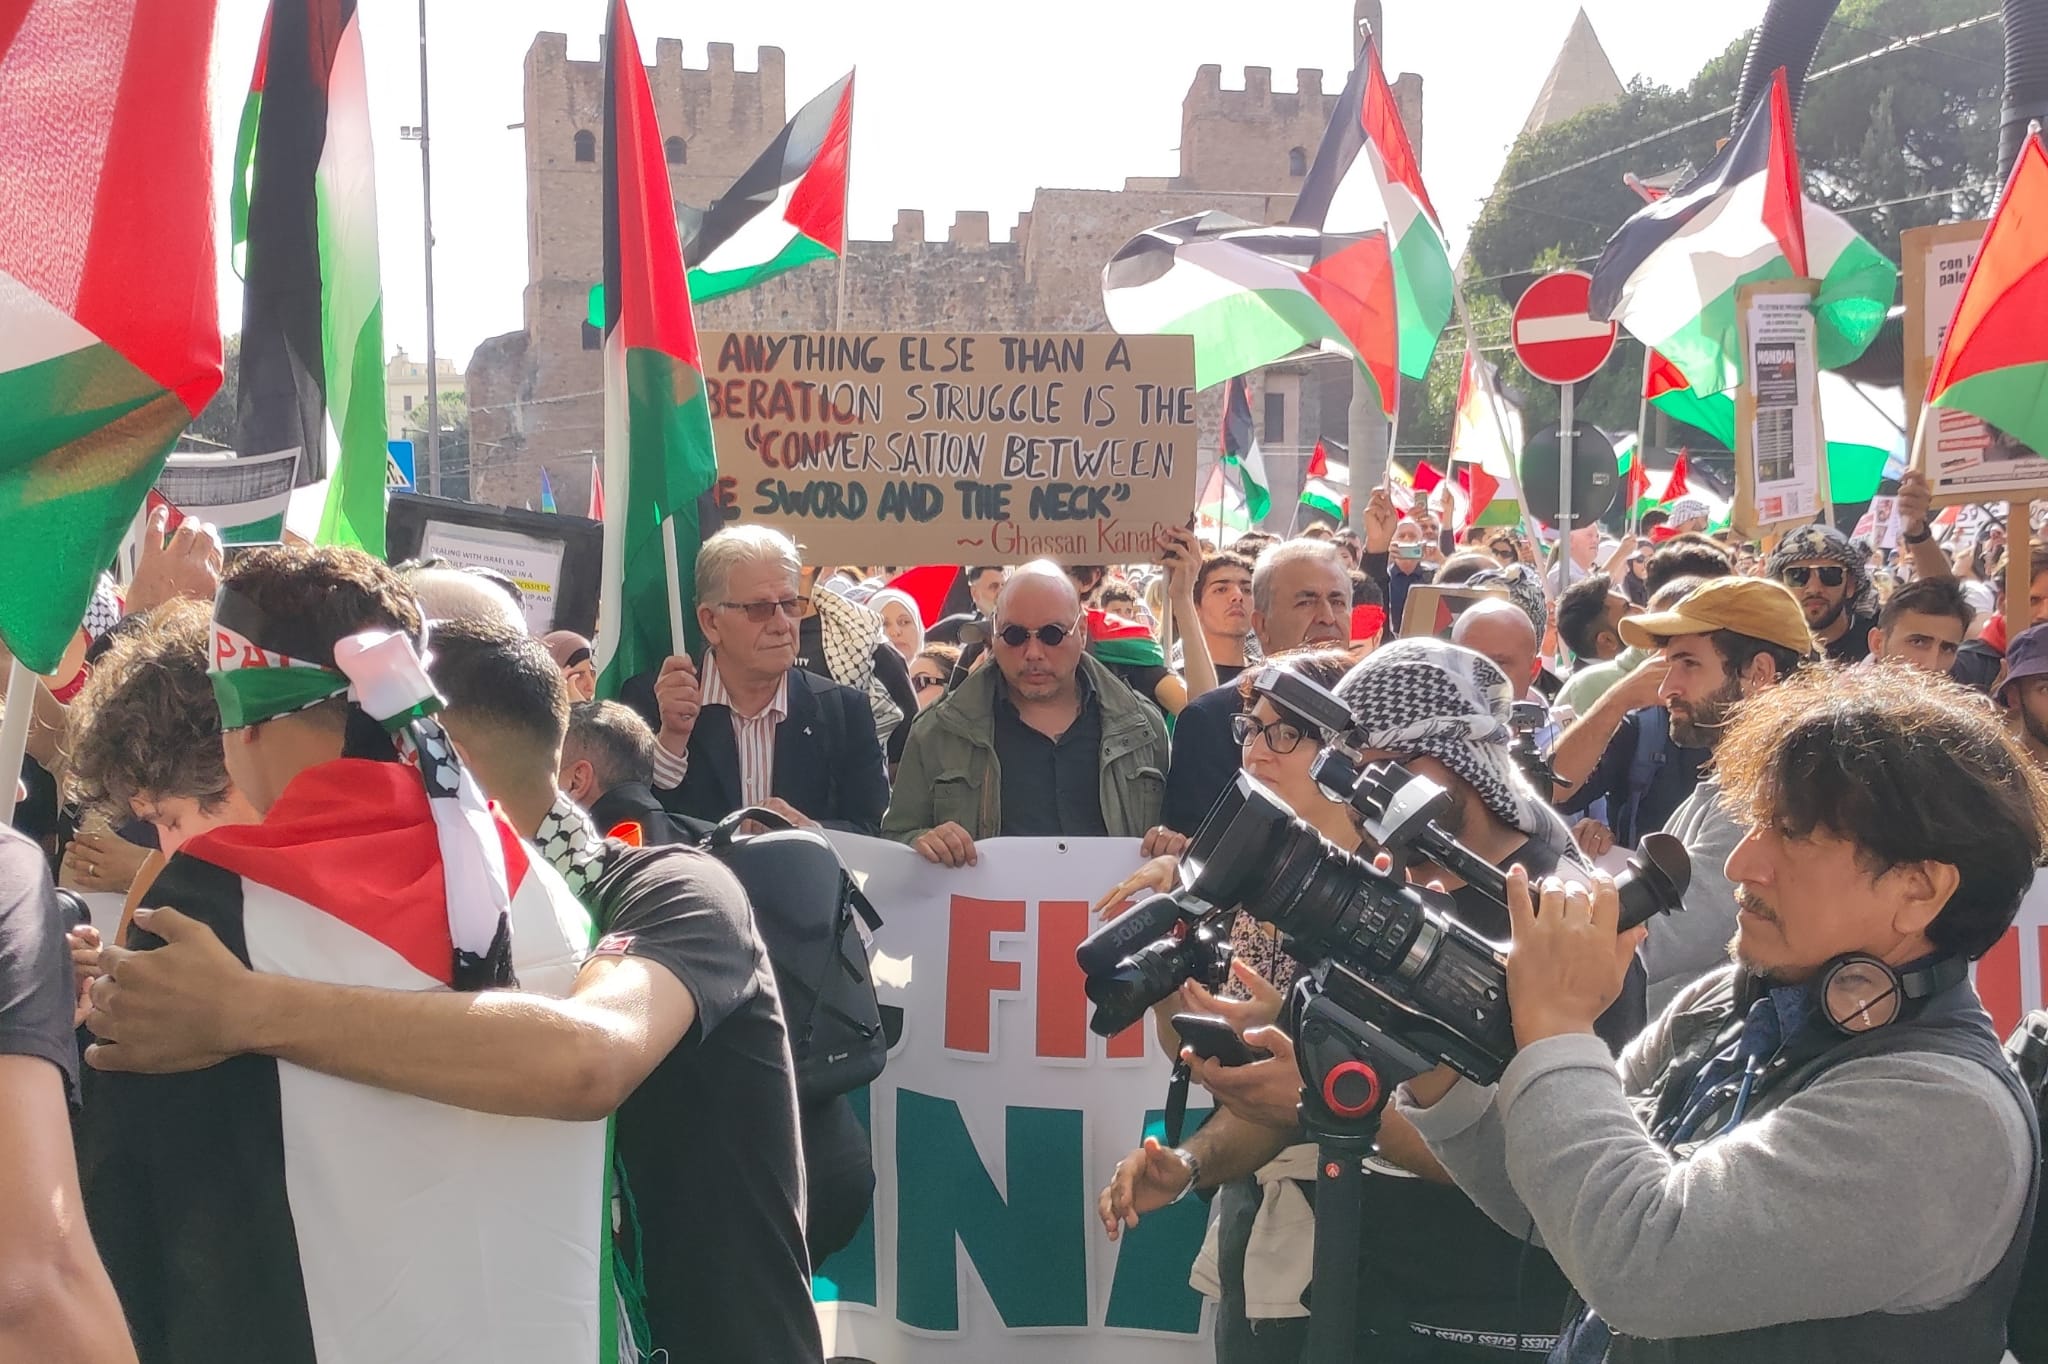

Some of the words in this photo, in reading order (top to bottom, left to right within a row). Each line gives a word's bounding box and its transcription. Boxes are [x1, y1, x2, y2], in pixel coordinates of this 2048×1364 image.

[1939, 256, 1963, 271] con
[1939, 270, 1967, 288] pale
[718, 332, 885, 373] ANYTHING
[899, 336, 975, 372] ELSE
[1000, 337, 1084, 373] THAN
[1105, 337, 1131, 372] A
[906, 381, 1064, 424] STRUGGLE
[1083, 384, 1116, 427] IS
[1134, 384, 1195, 426] THE
[1003, 436, 1174, 479] BETWEEN
[753, 478, 868, 520] SWORD
[877, 480, 944, 523] AND
[954, 480, 1013, 521] THE
[991, 519, 1087, 555] Ghassan
[1097, 518, 1166, 555] Kanaf
[430, 545, 461, 558] DEALING
[462, 550, 482, 561] WITH
[483, 555, 506, 566] ISRAEL
[507, 558, 514, 566] IS
[515, 559, 525, 567] SO
[536, 595, 552, 603] AND
[1478, 1334, 1516, 1347] GUESS
